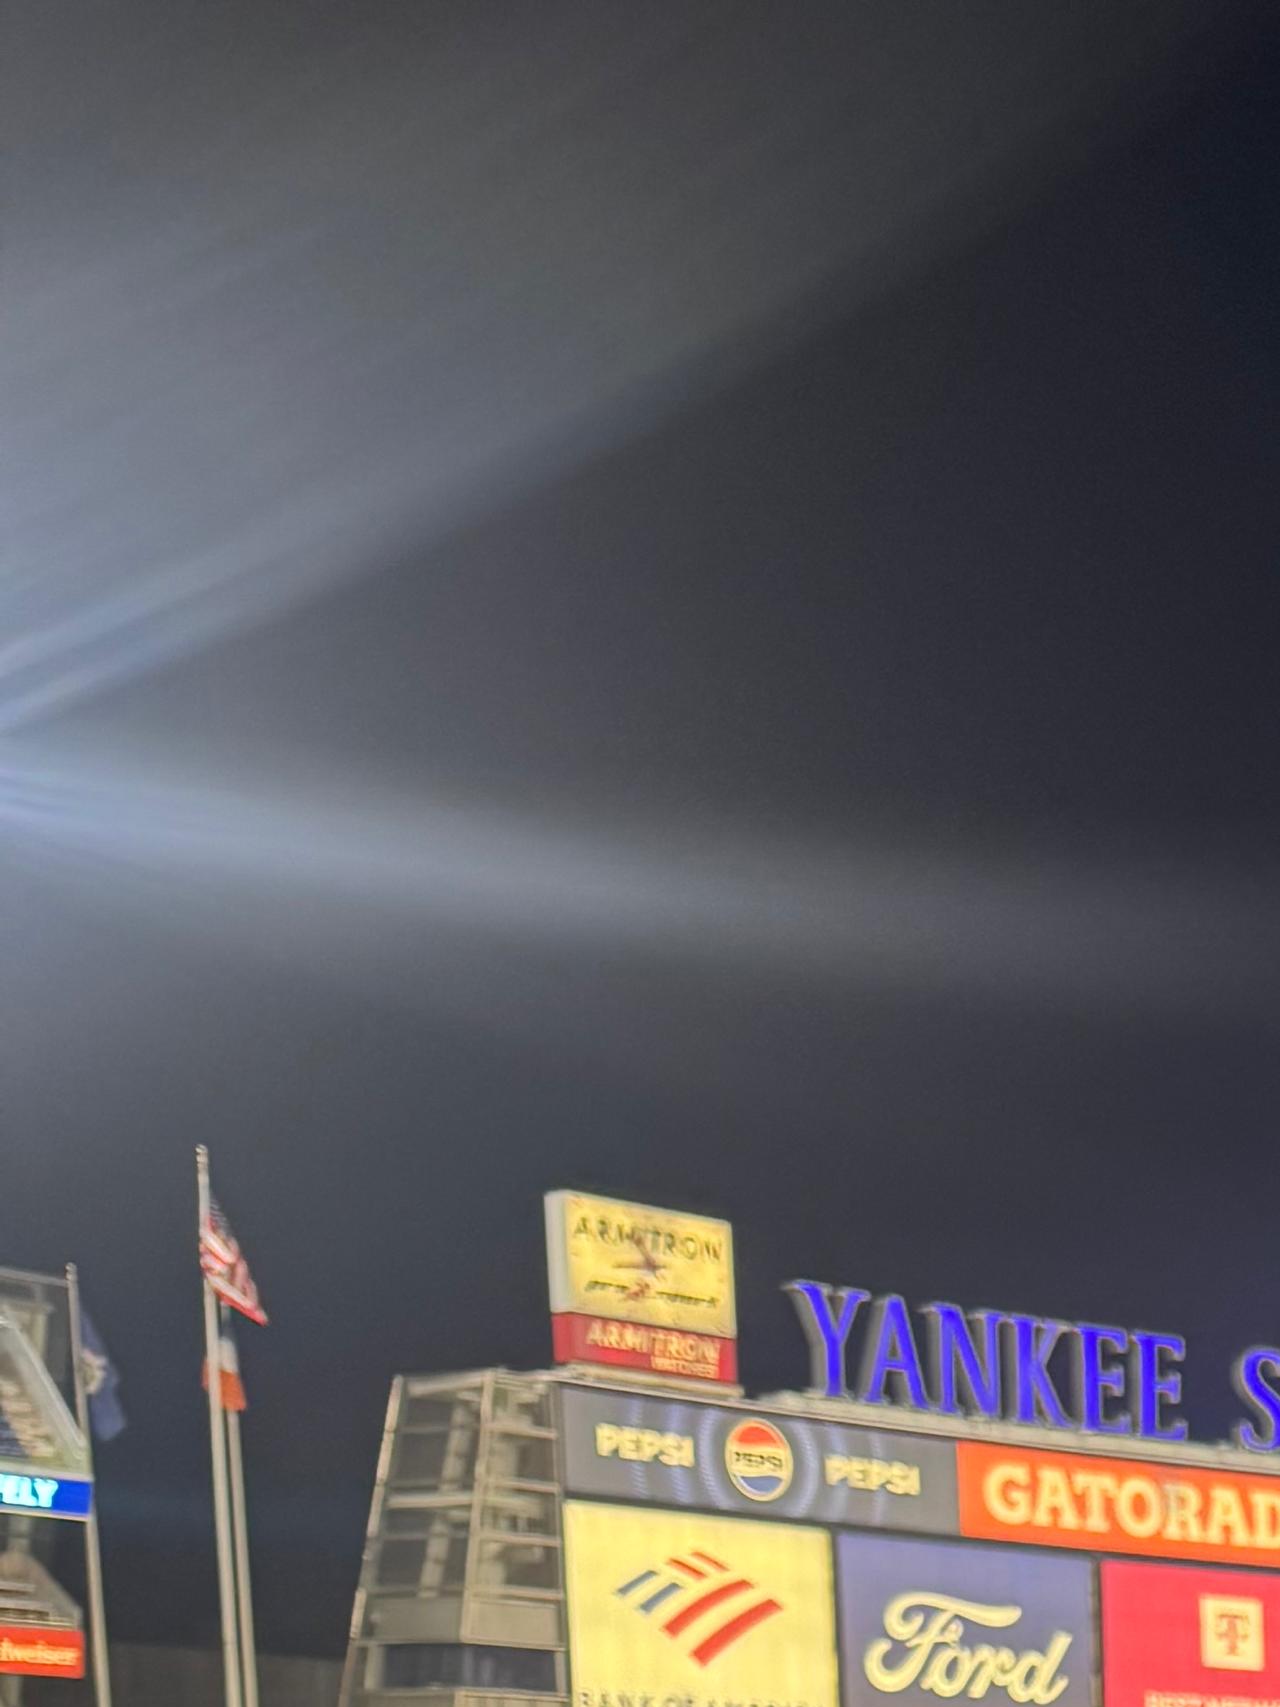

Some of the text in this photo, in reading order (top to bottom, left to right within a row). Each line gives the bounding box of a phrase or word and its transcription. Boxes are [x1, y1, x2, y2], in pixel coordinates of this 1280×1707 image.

[786, 1279, 1187, 1441] YANKEE
[594, 1422, 695, 1468] PEPSI
[824, 1454, 922, 1496] PEPSI
[864, 1591, 1072, 1705] Ford
